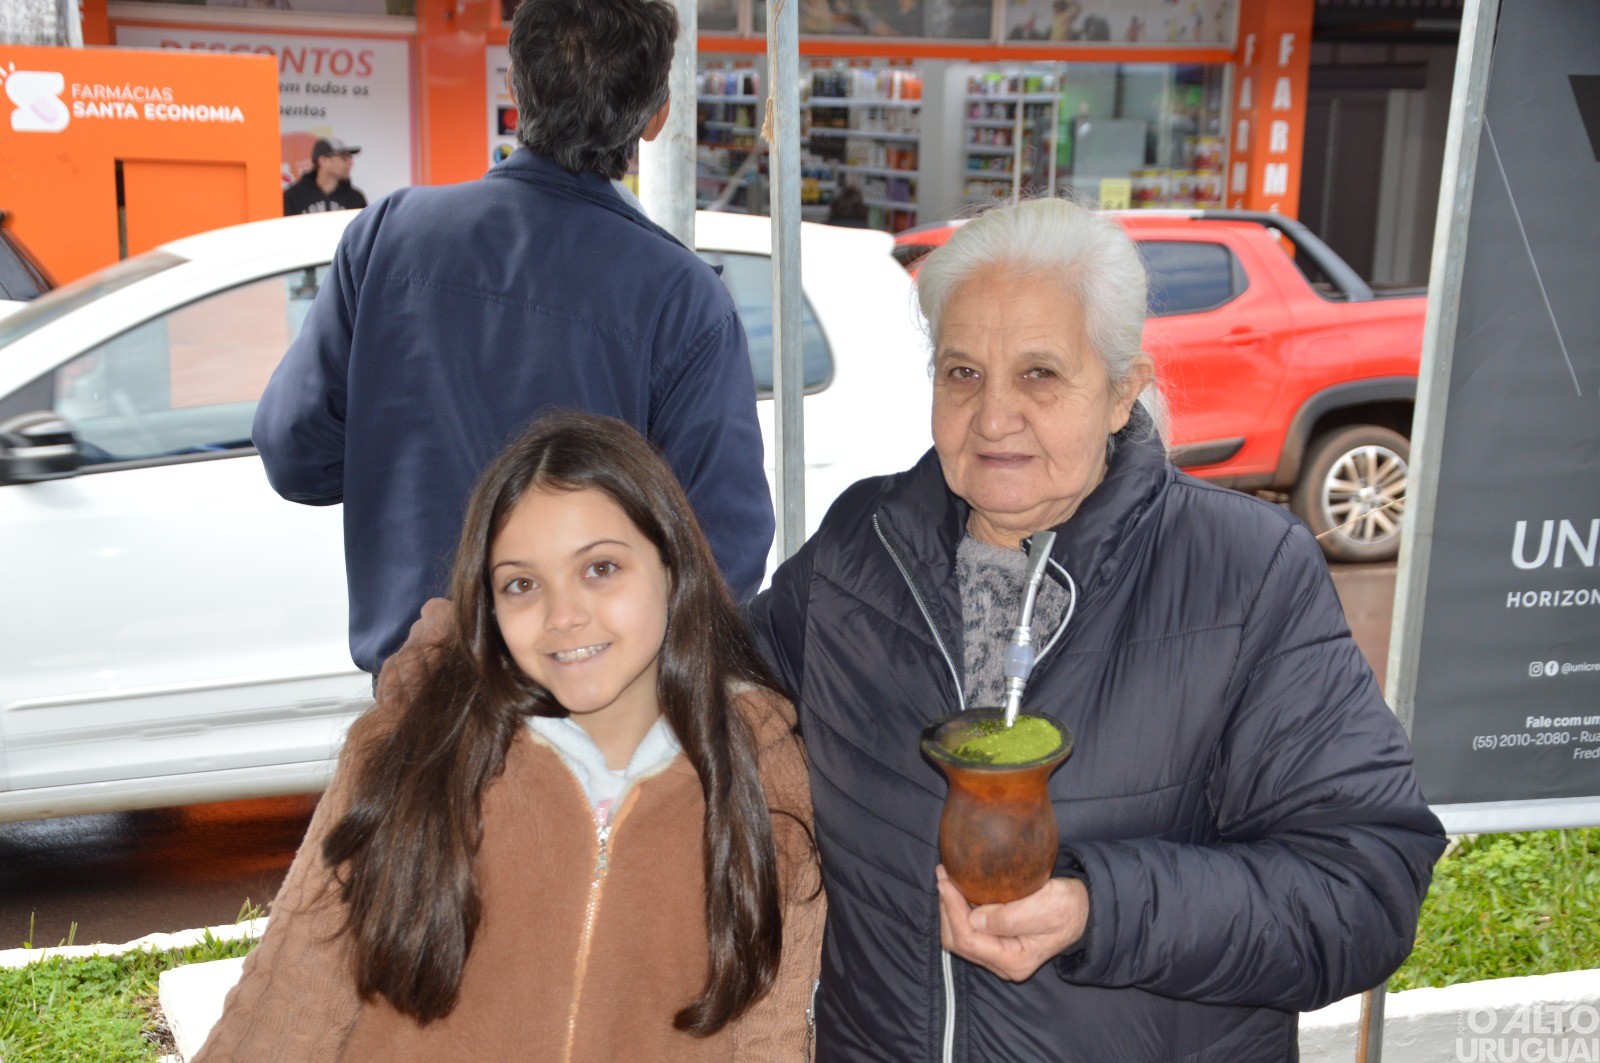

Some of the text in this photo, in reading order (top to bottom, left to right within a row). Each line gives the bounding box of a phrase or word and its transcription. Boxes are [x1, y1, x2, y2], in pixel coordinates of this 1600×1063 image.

[71, 82, 174, 102] FARMÁCIAS
[305, 80, 347, 95] todos
[353, 84, 369, 95] os
[73, 101, 245, 122] SANTA ECONOMIA
[1262, 33, 1295, 212] FARM
[1511, 518, 1600, 569] UN
[1526, 716, 1552, 728] Fale
[1553, 716, 1582, 727] com
[1473, 735, 1498, 750] (55)
[1499, 731, 1570, 747] 2010-2080
